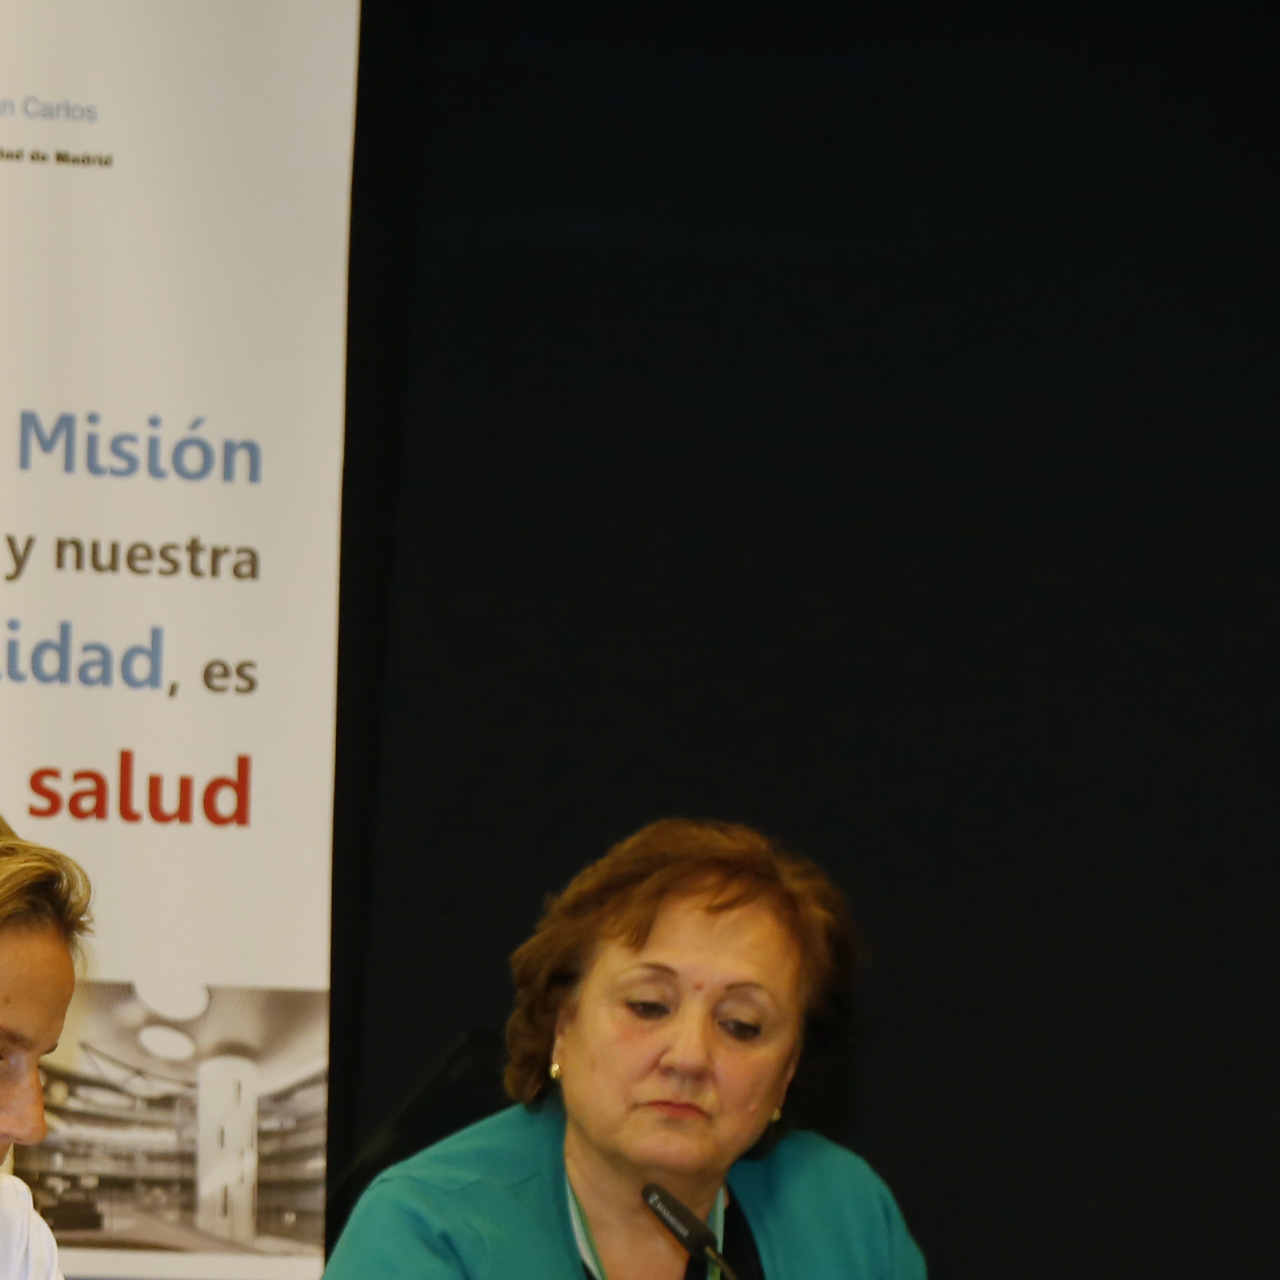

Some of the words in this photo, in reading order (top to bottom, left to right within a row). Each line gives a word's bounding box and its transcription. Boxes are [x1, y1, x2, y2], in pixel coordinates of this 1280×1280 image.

[22, 96, 98, 122] Carlos
[30, 149, 49, 164] de
[56, 152, 113, 168] Madrid
[18, 410, 263, 484] Misión
[4, 532, 35, 581] y
[54, 534, 260, 580] nuestra
[202, 653, 259, 695] es
[28, 748, 252, 827] salud
